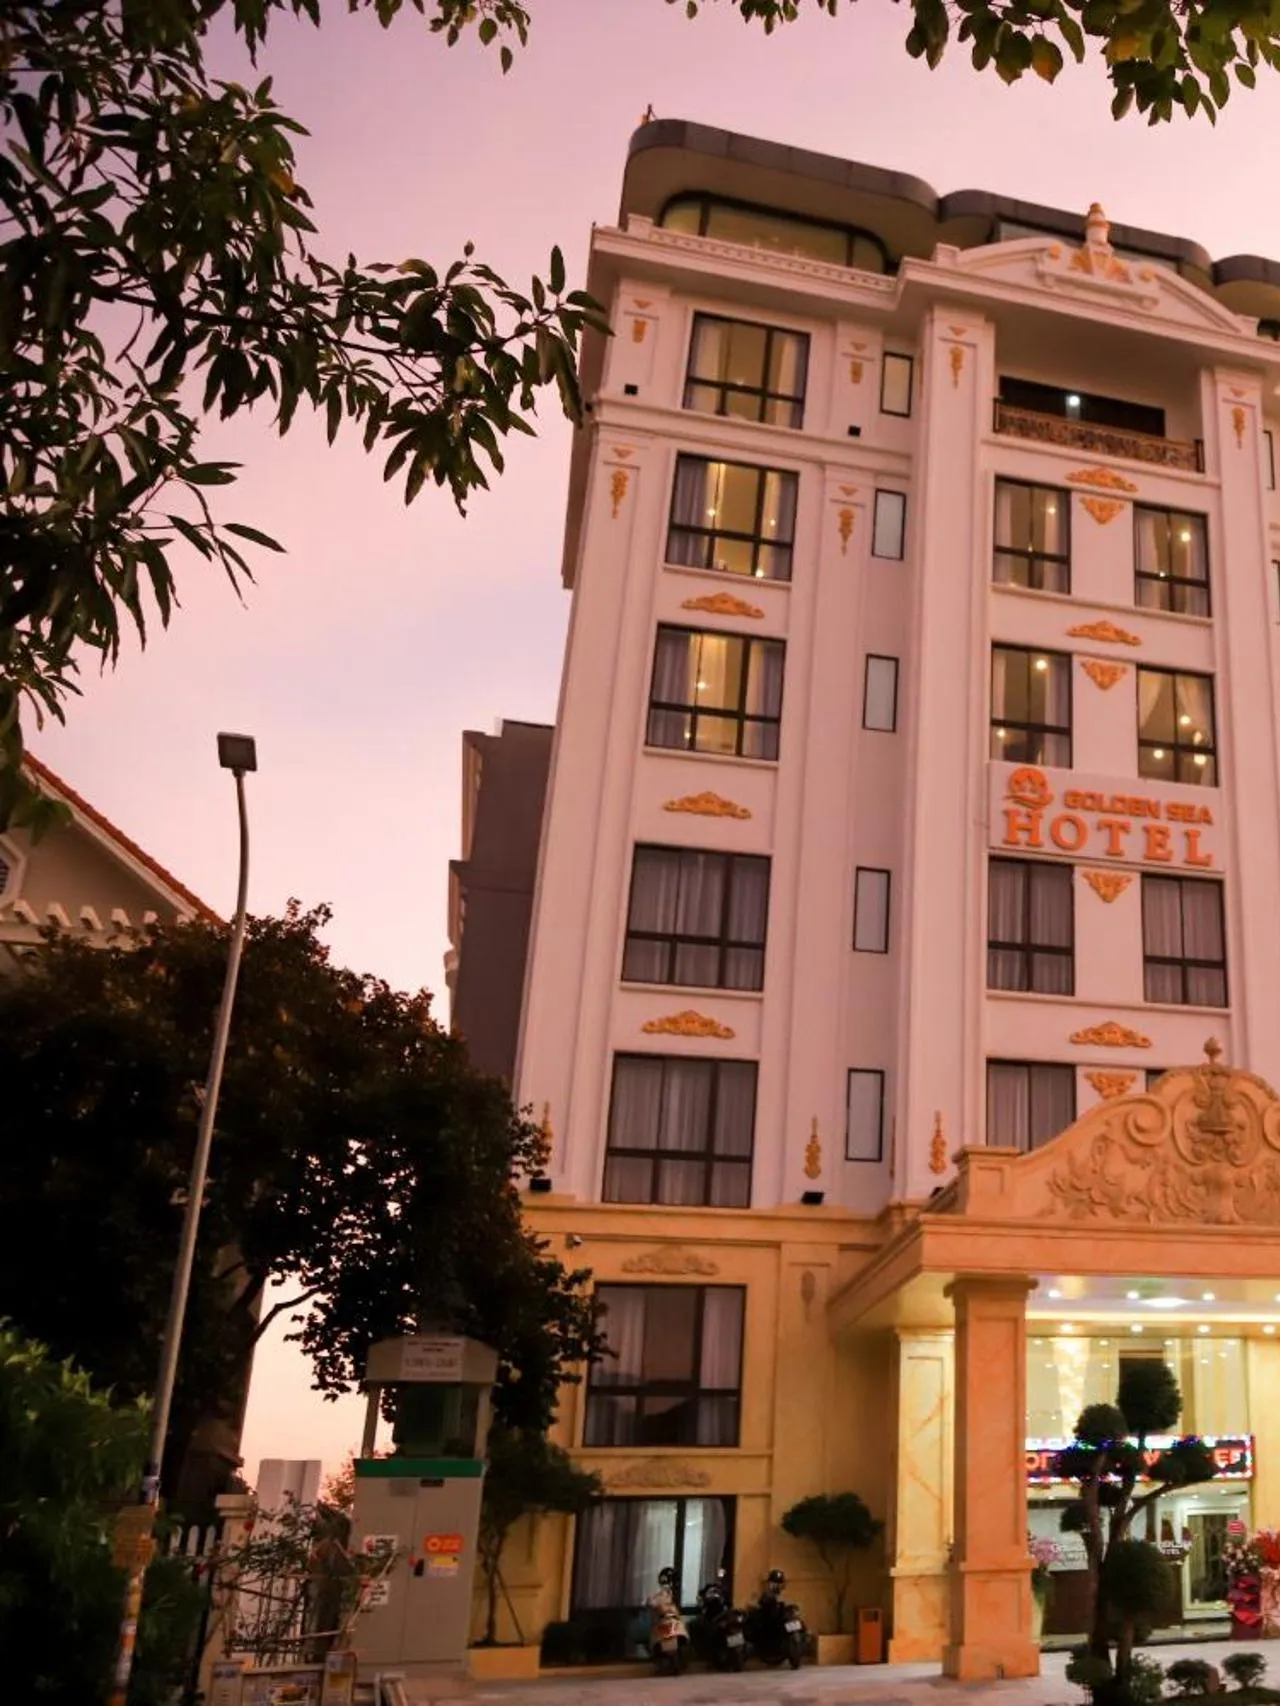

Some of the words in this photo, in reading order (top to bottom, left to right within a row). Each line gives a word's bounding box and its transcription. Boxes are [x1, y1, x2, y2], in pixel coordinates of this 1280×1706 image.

[1063, 789, 1161, 819] GOLDEN
[1165, 802, 1214, 825] SEA
[1003, 809, 1213, 866] HOTEL
